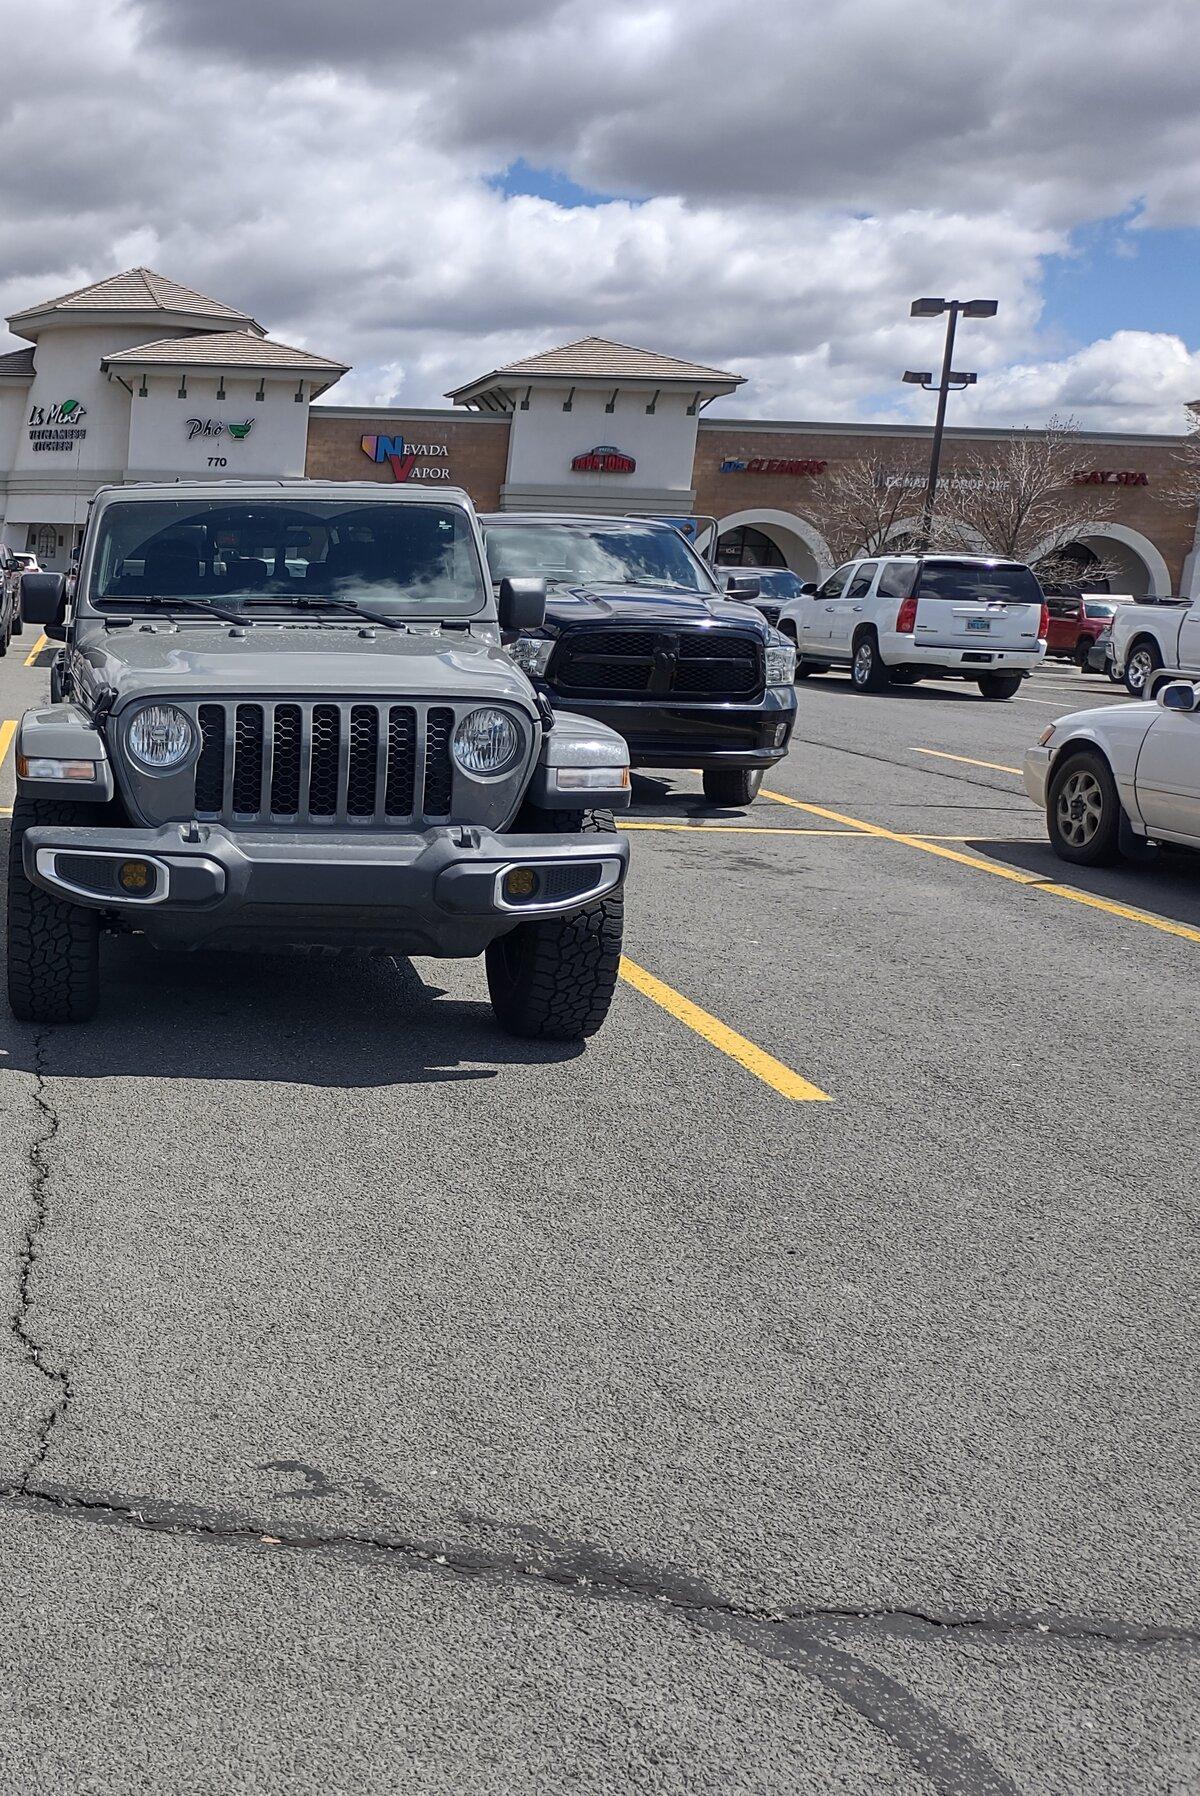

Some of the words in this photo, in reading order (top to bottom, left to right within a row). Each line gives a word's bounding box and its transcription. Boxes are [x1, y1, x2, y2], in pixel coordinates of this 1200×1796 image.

[46, 404, 87, 424] Mint
[207, 457, 227, 467] 770
[747, 459, 828, 475] CLEANERS
